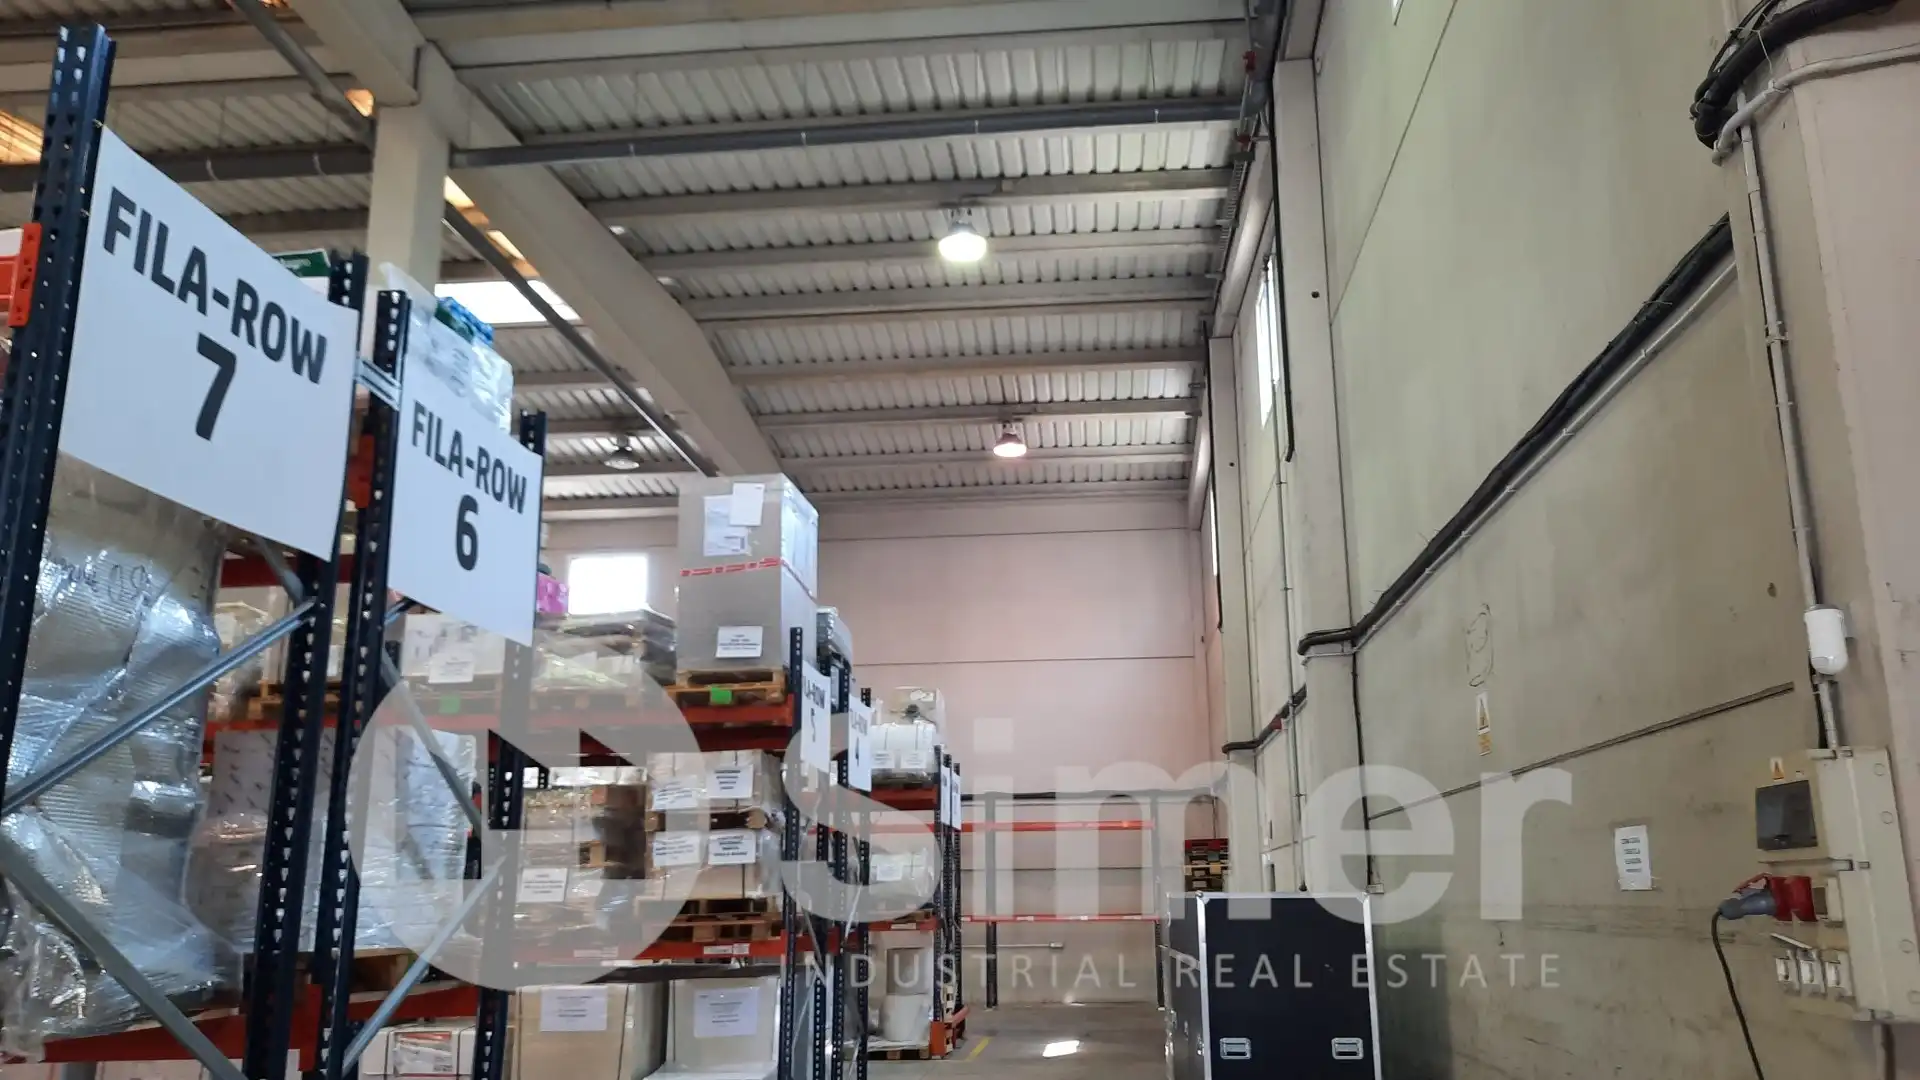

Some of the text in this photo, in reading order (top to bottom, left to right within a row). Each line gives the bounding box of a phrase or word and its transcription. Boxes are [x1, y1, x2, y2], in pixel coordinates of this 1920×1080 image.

[102, 186, 327, 385] FILA-ROW
[195, 332, 237, 442] 7
[411, 400, 528, 514] FILA-ROW
[455, 494, 479, 571] 6
